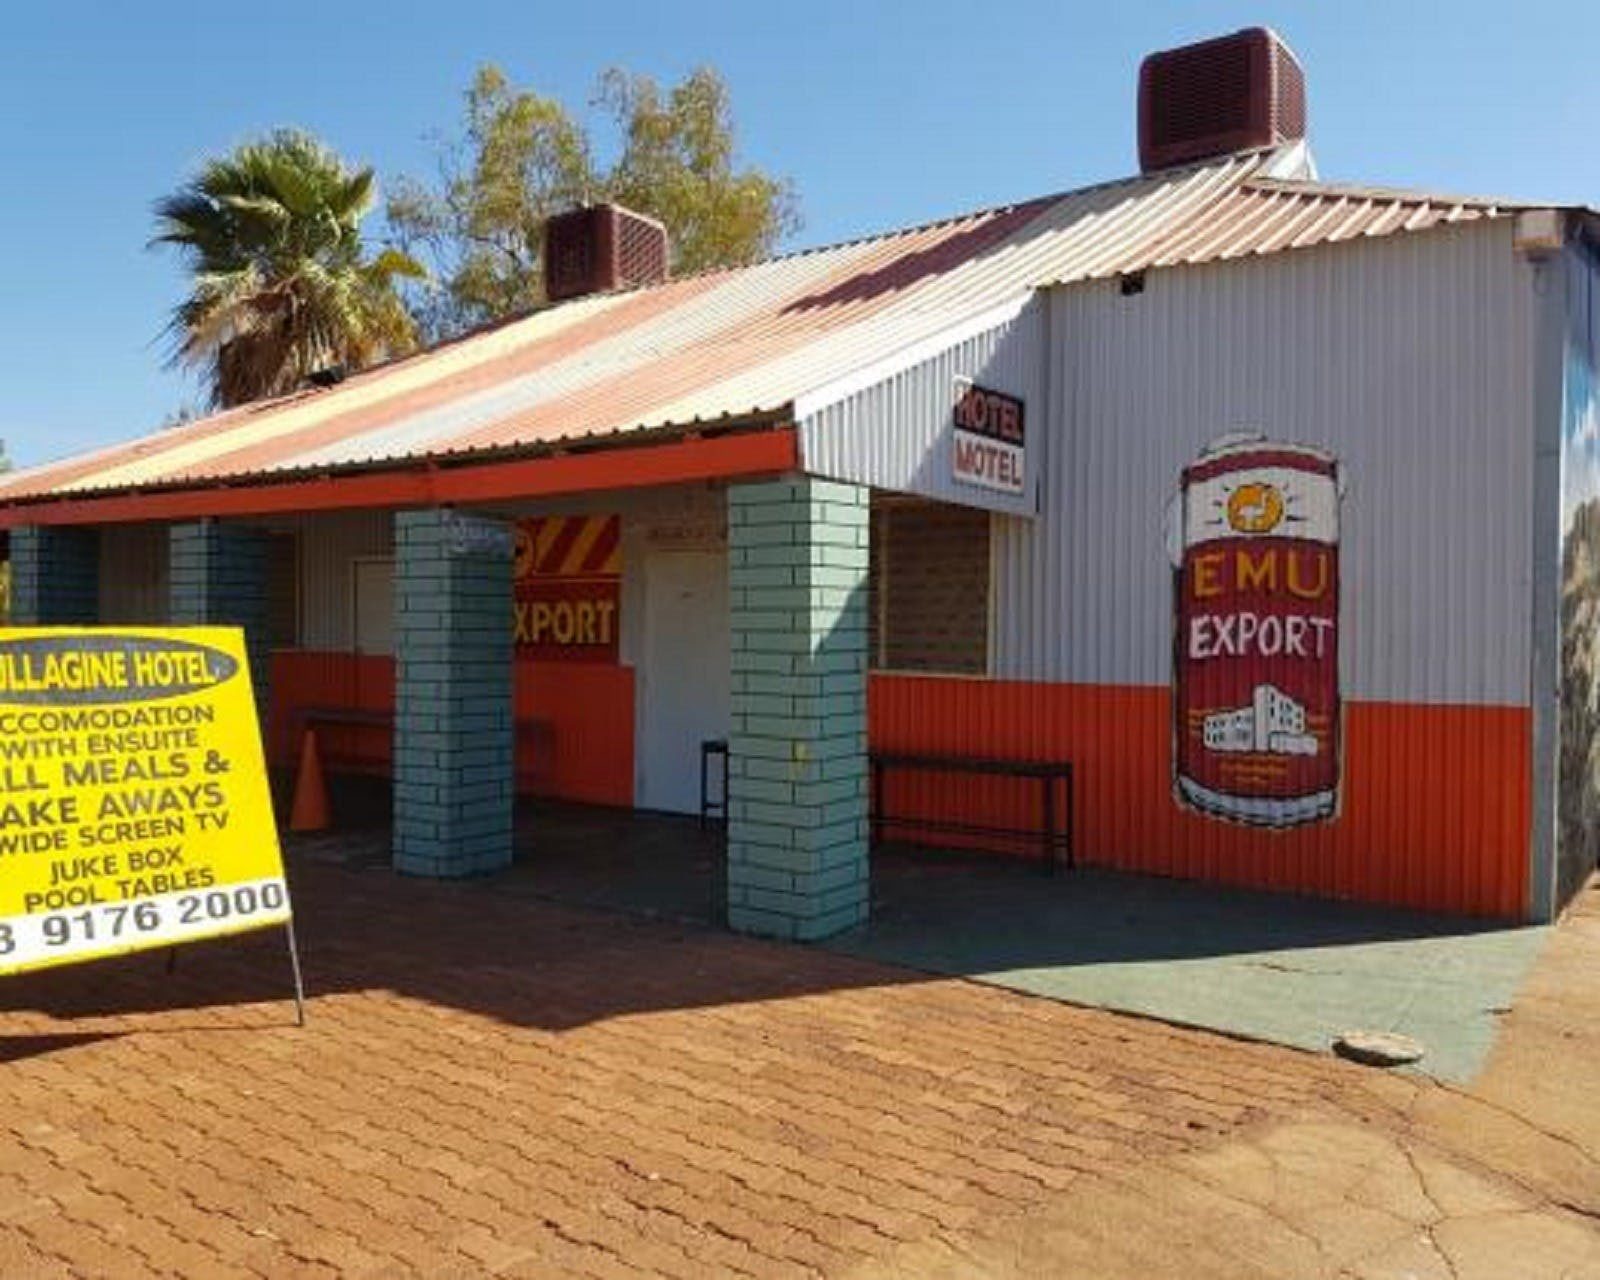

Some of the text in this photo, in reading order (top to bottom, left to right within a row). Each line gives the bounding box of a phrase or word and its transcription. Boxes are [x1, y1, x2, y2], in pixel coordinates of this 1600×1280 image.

[956, 438, 1022, 486] MOTEL
[1193, 550, 1327, 598] EMU
[1189, 611, 1333, 660] EXPORT
[134, 651, 217, 687] HOTEL
[0, 728, 199, 760] WITH ENSUITE
[0, 750, 231, 792] LL MEALS &
[97, 784, 224, 821] AWAYS
[78, 817, 185, 847] SCREEN
[195, 812, 231, 833] TV
[50, 847, 184, 885] JUKE BOX
[24, 868, 215, 914] POOL TABLES
[42, 902, 162, 947] 9176
[178, 883, 283, 924] 2000
